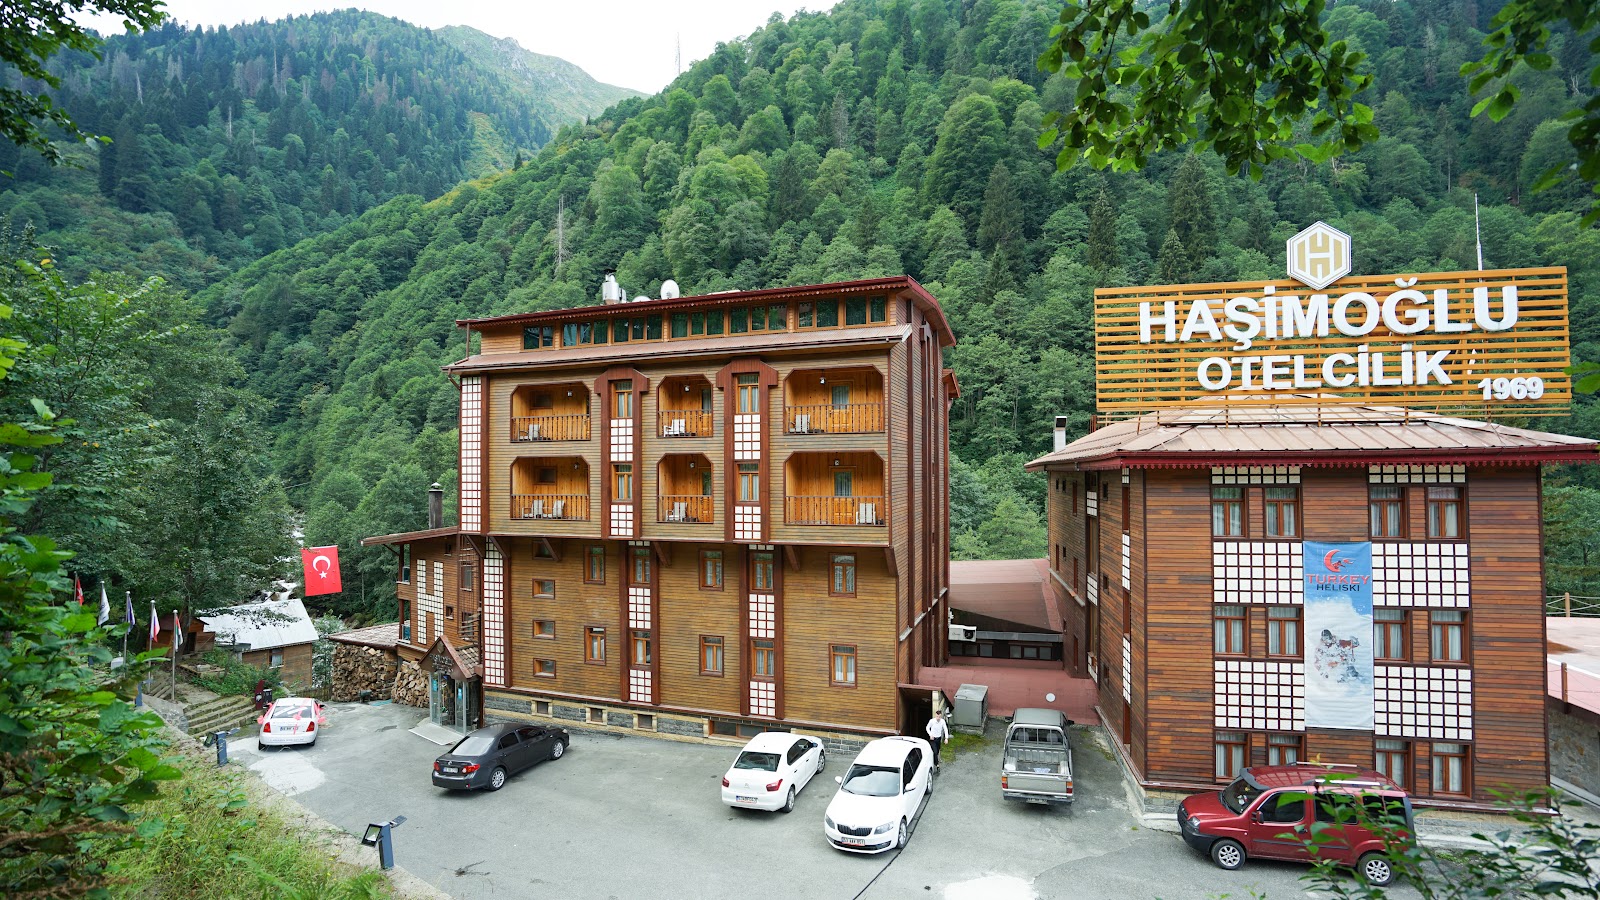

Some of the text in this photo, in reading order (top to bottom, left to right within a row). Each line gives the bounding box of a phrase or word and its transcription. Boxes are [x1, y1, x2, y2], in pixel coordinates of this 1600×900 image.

[1138, 277, 1519, 352] HAŞİMOĞLU
[1197, 344, 1453, 391] OTELCİLİK
[1477, 377, 1545, 401] 1969
[1306, 574, 1370, 584] TURKEY
